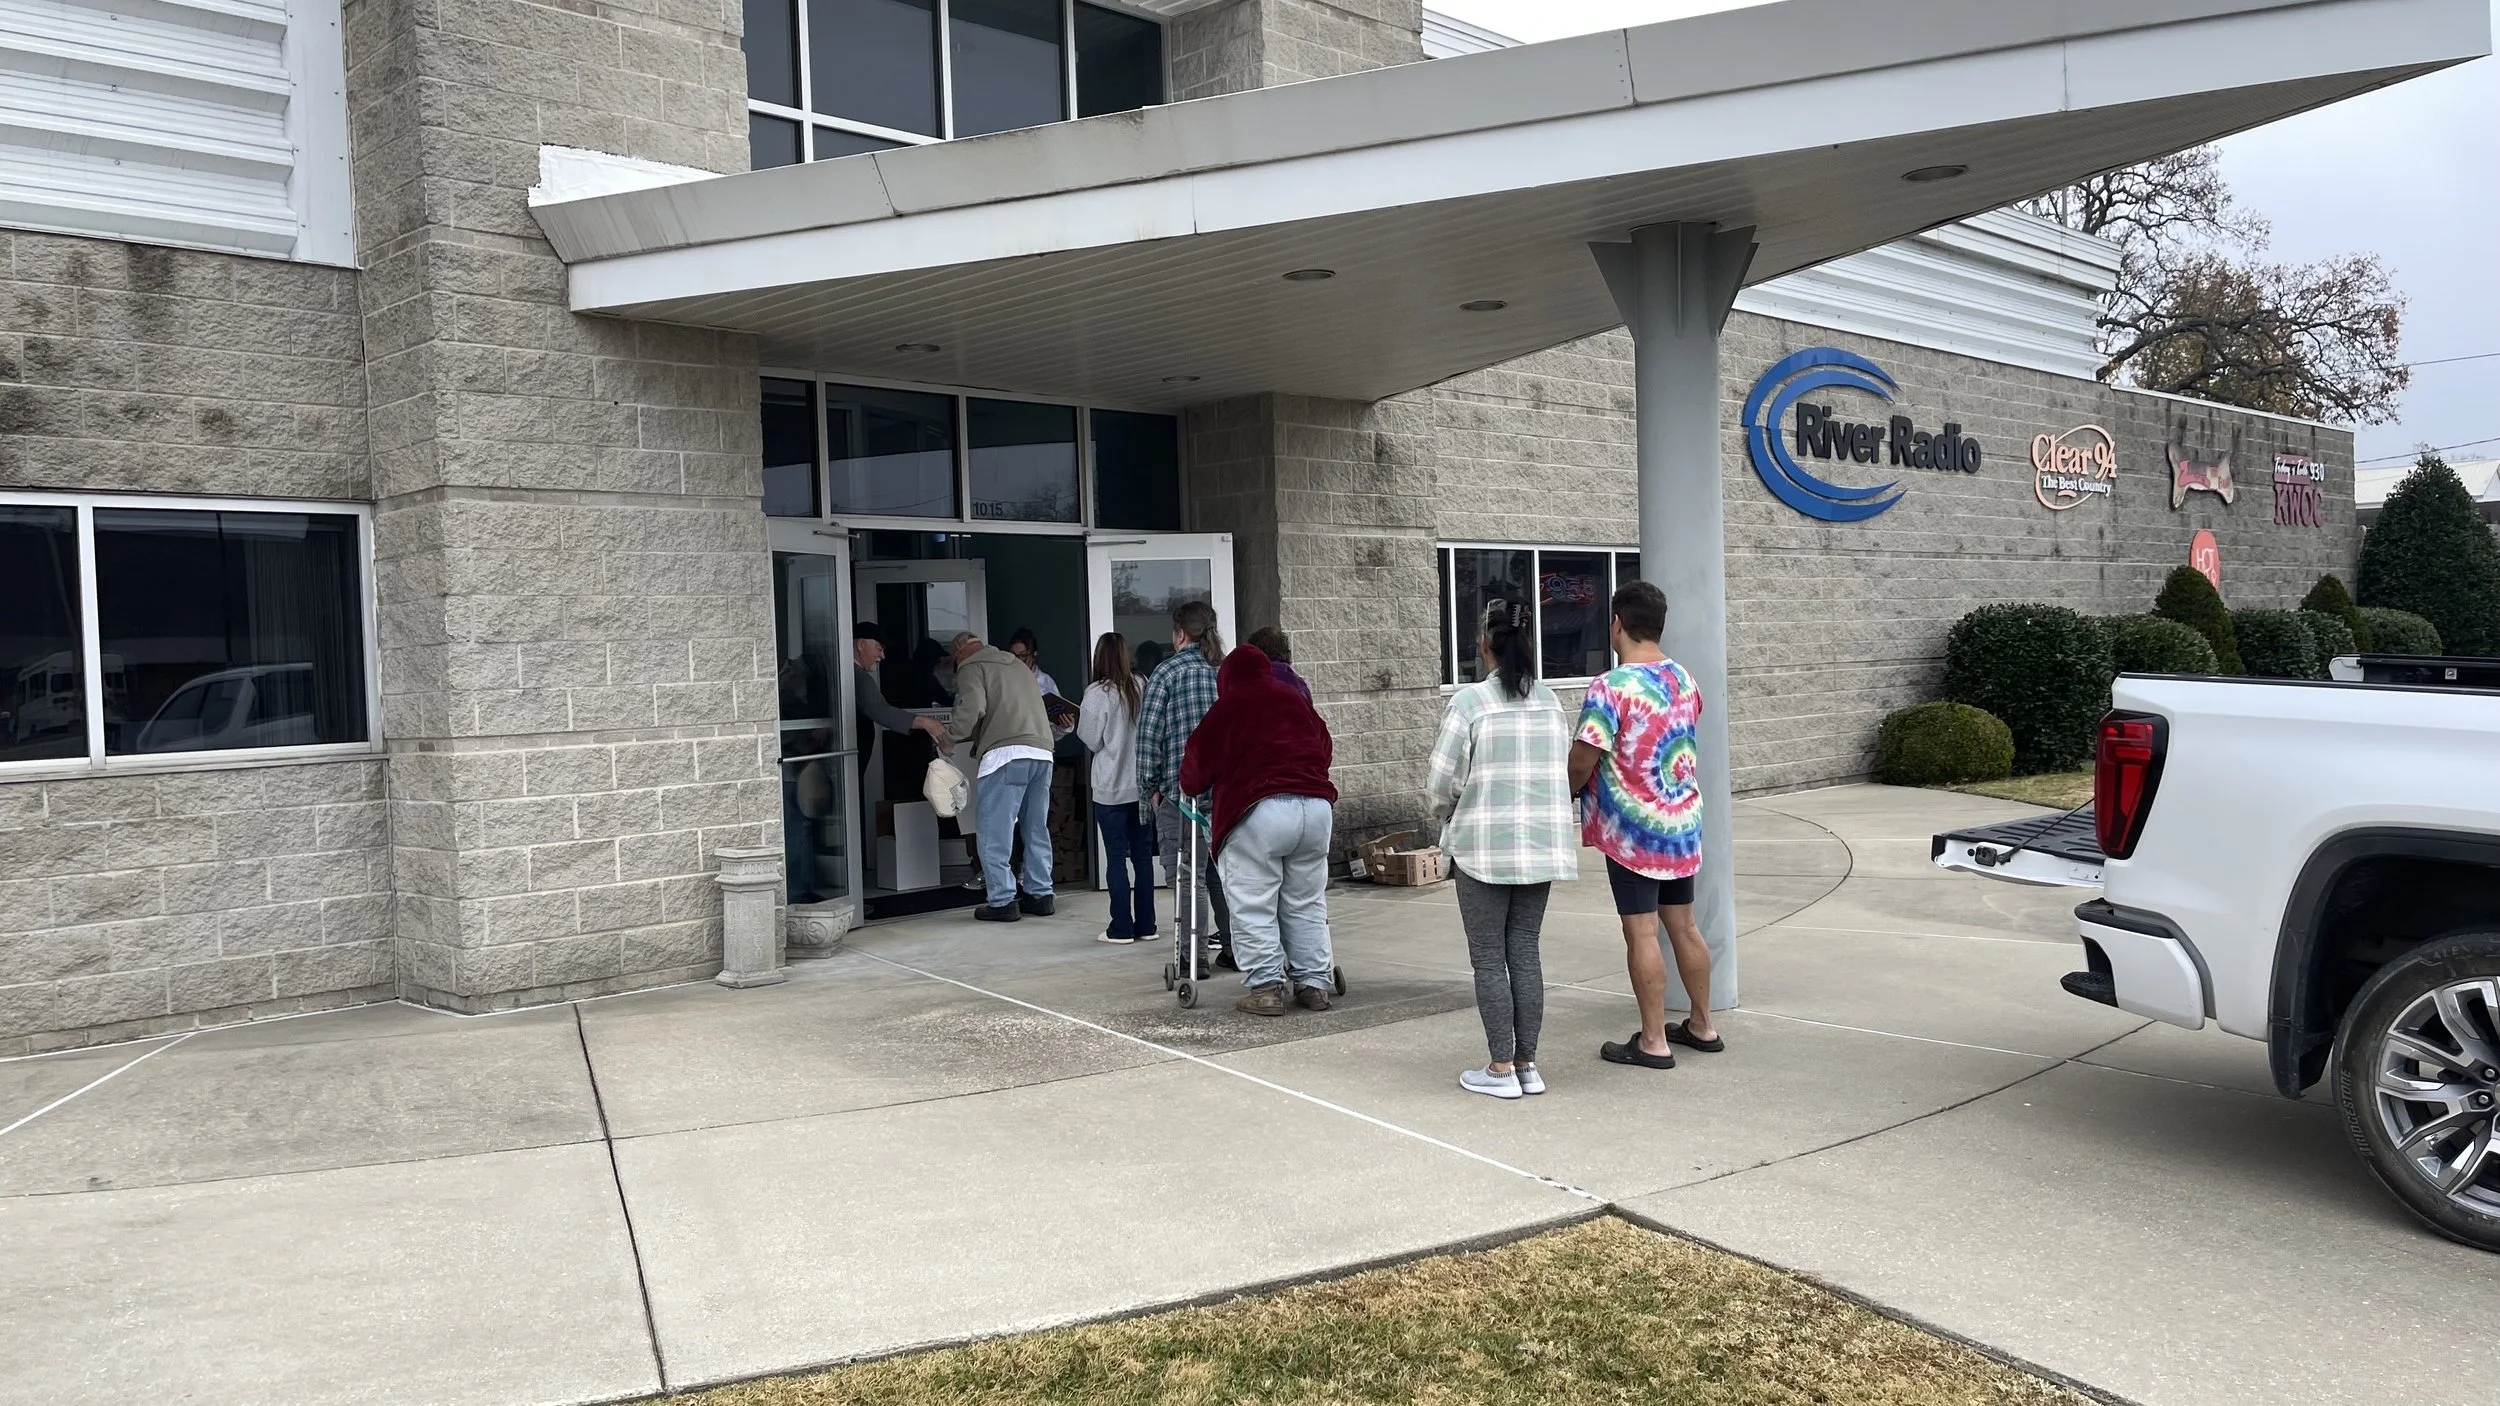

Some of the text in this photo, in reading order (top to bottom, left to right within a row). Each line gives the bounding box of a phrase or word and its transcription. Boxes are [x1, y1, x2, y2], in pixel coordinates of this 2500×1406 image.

[1796, 402, 1982, 474] River Radio
[2032, 433, 2117, 479] Clear 94
[2309, 461, 2325, 482] 930
[2042, 474, 2112, 497] The Best Country
[973, 501, 1003, 517] 1015
[2274, 484, 2326, 527] KWOC
[2196, 548, 2215, 571] HOT
[2340, 1068, 2375, 1158] BRIDGESTONE
